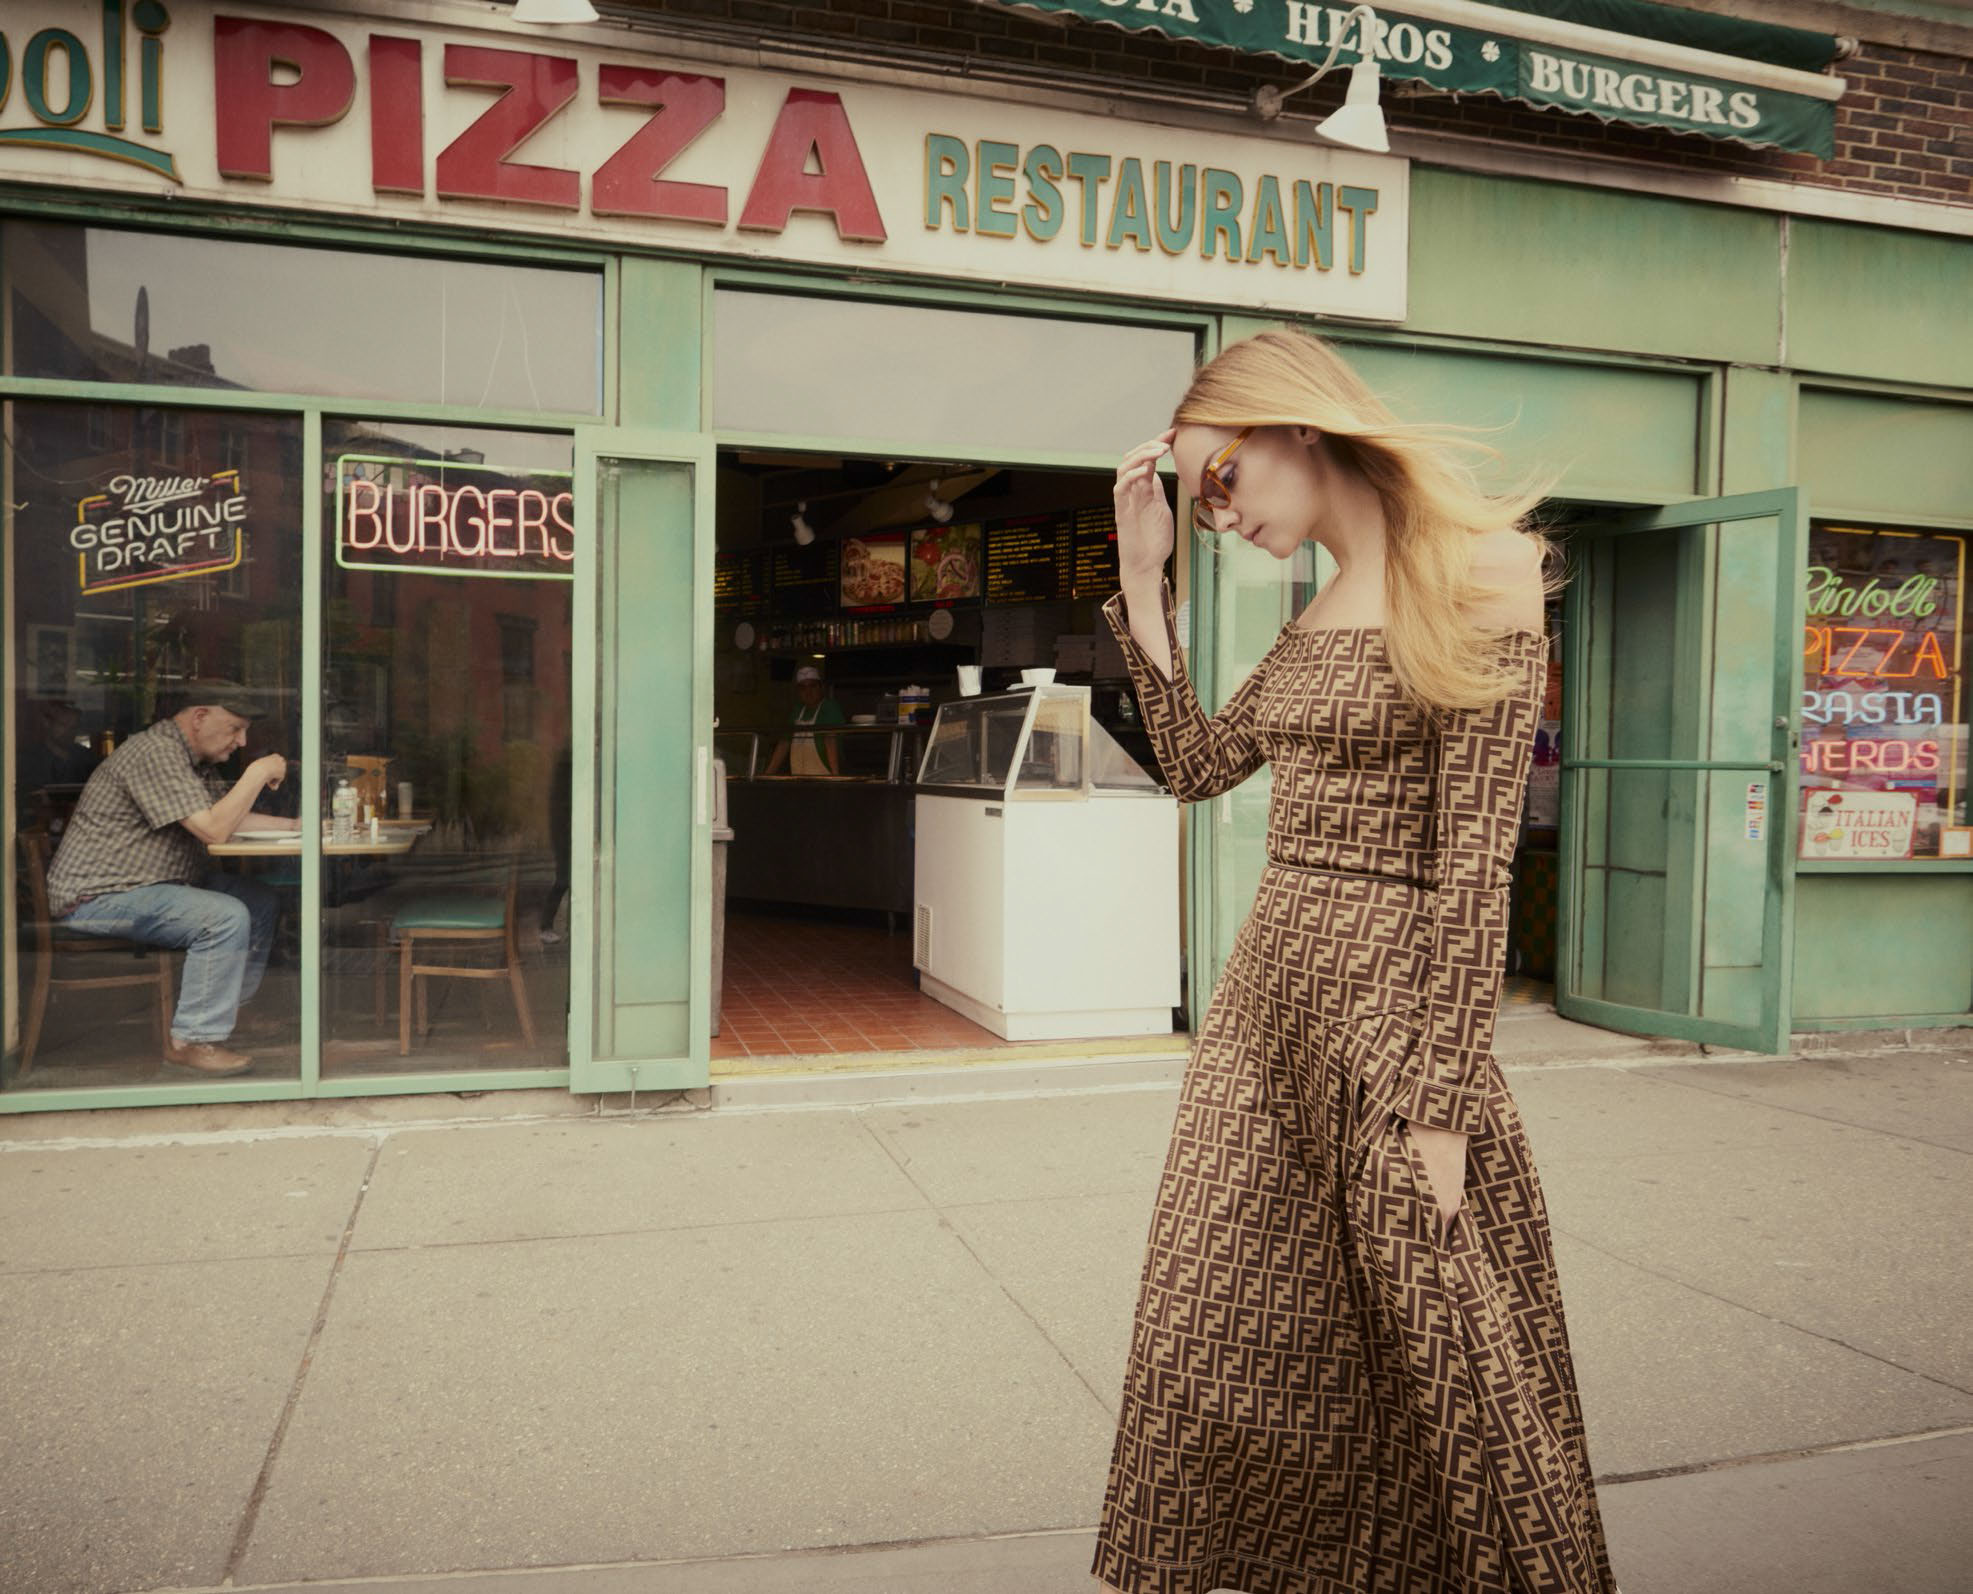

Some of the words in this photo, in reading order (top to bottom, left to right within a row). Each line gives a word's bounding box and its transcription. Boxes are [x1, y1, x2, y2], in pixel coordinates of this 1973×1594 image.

[1284, 1, 1453, 70] HEROS
[1529, 51, 1761, 128] BURGERS
[0, 0, 171, 133] oli
[214, 15, 888, 243] PIZZA
[924, 132, 1379, 274] RESTAURANT
[109, 474, 210, 504] Miller
[70, 496, 247, 549] GENUINE
[348, 481, 574, 560] BURGERS
[97, 527, 222, 571] DRAFT
[1835, 810, 1911, 828] ITALIAN
[1850, 831, 1891, 848] ICES
